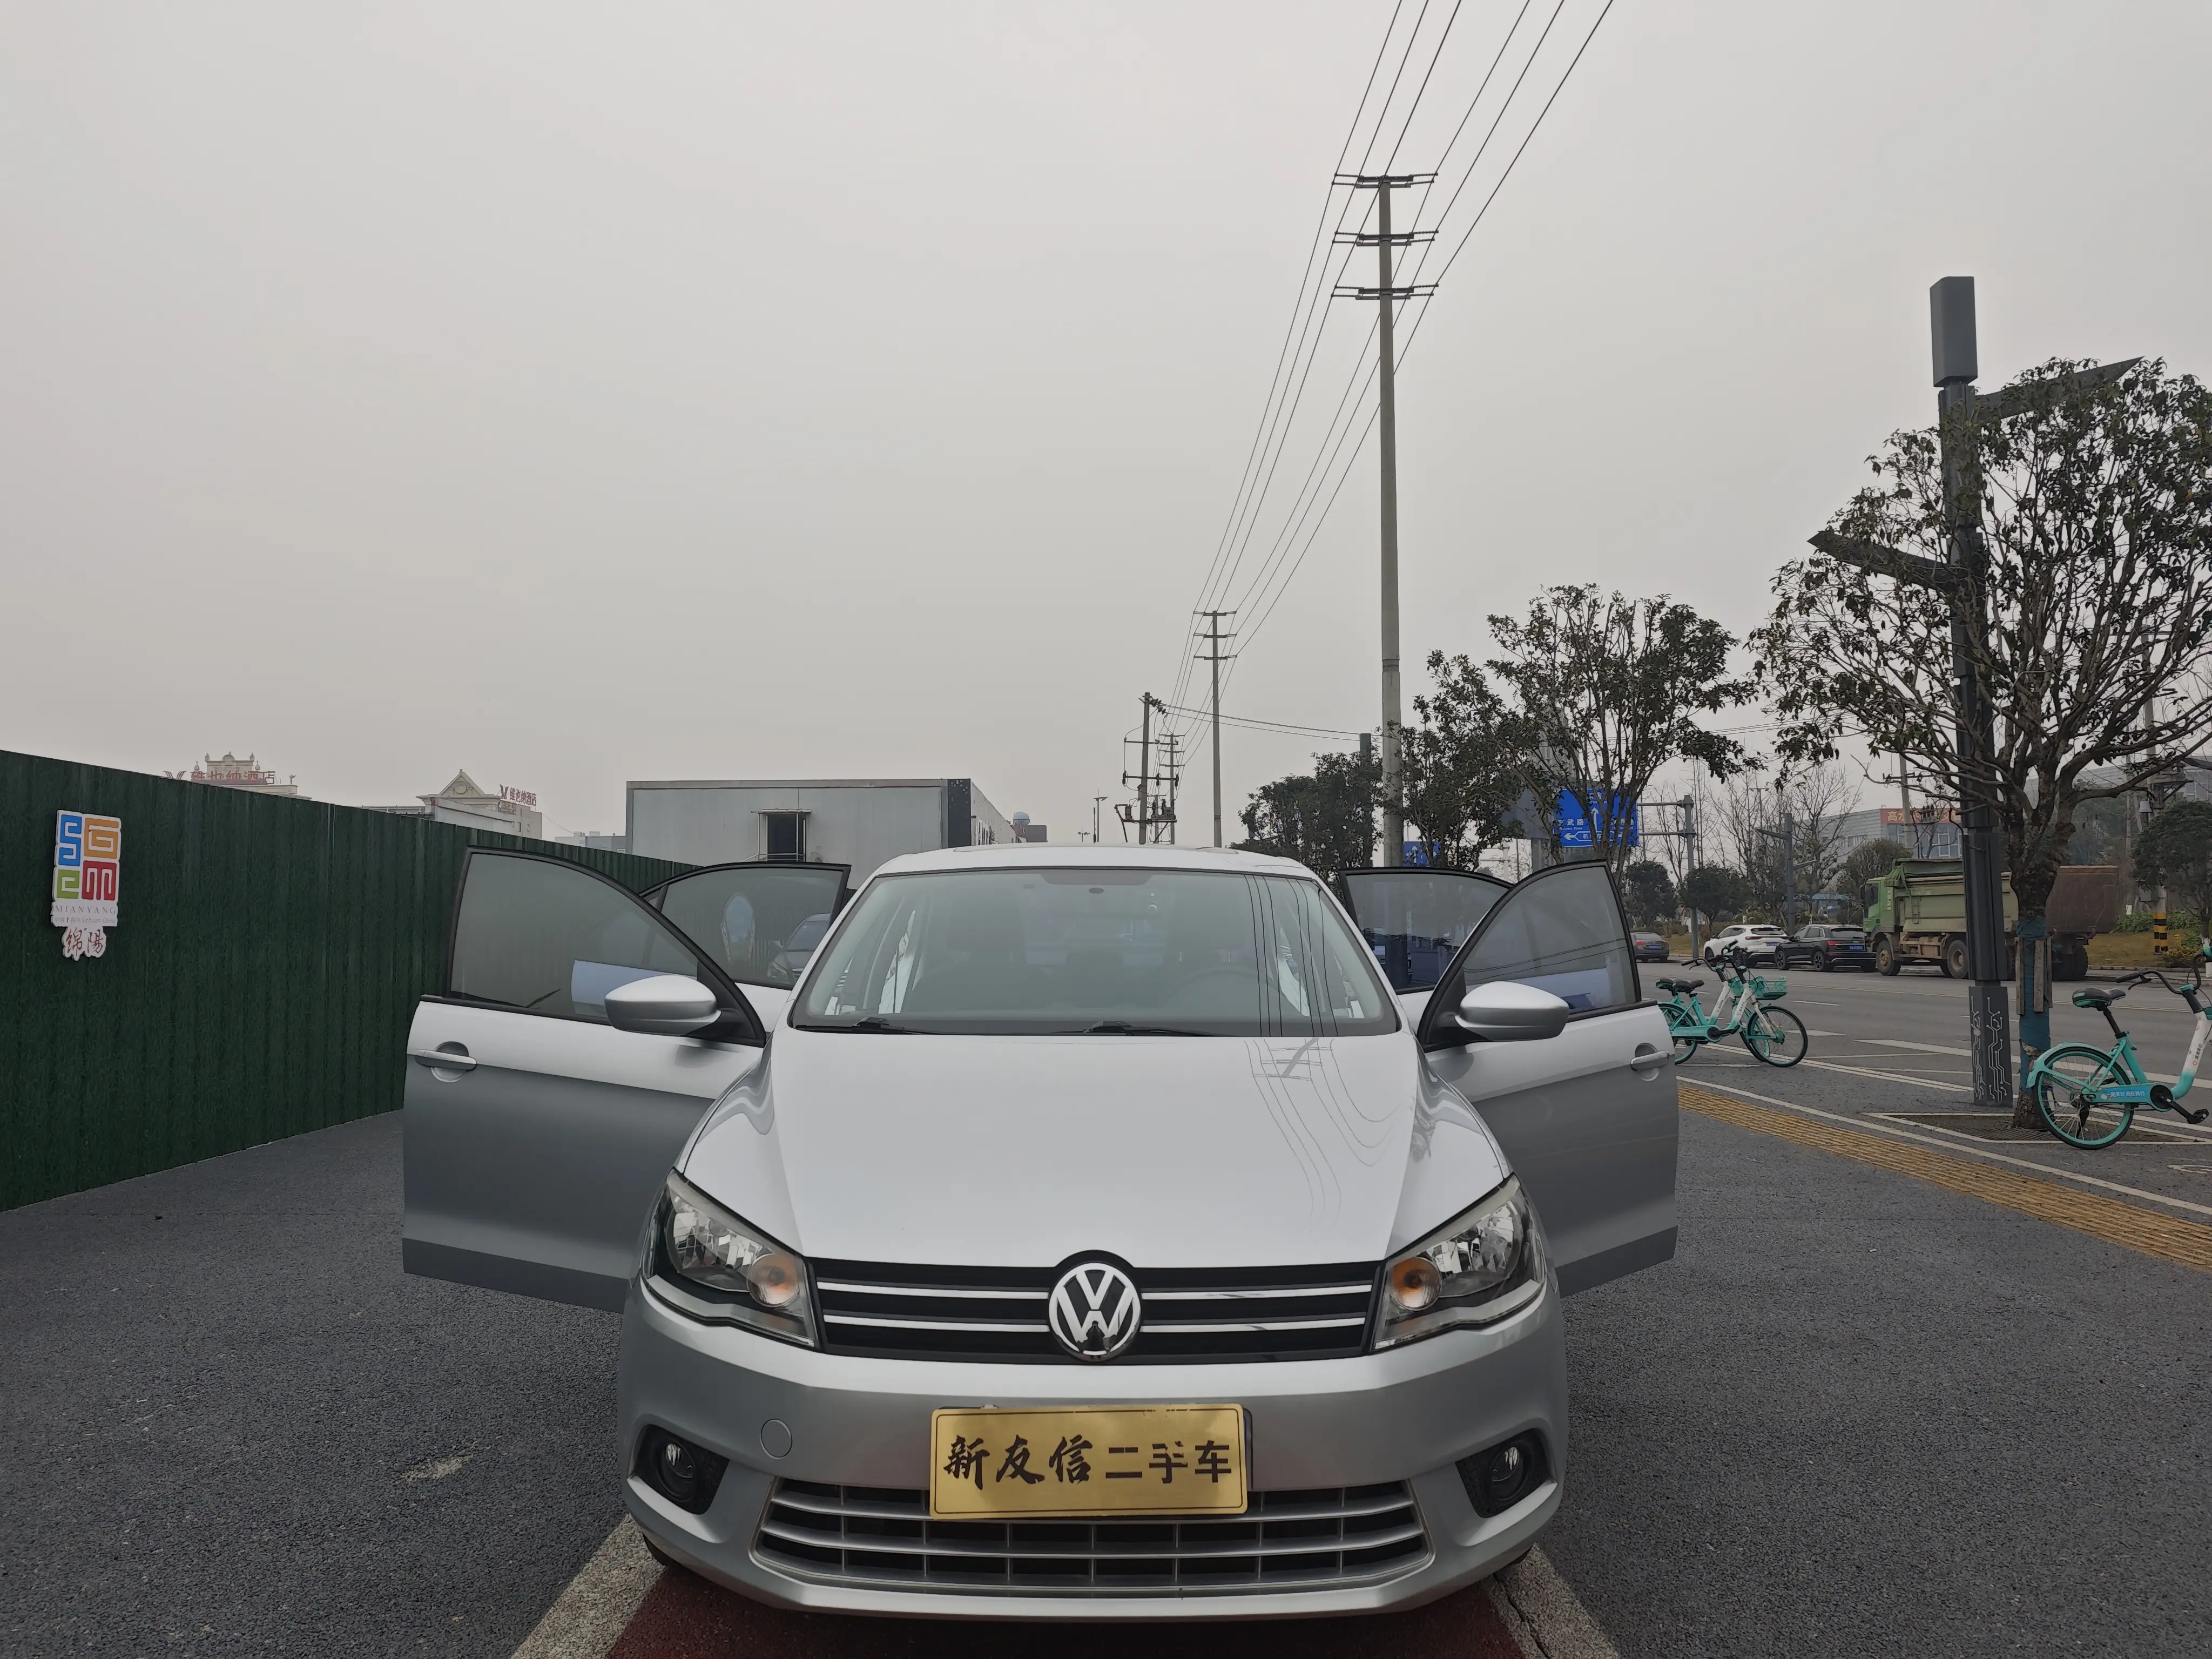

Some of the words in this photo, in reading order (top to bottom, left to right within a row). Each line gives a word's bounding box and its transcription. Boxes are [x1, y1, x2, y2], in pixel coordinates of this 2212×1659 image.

[190, 770, 276, 784] 维也纳酒店
[510, 787, 537, 806] 维也纳酒店
[55, 905, 116, 915] MIANYANG
[943, 1434, 1232, 1490] 新友信二手车
